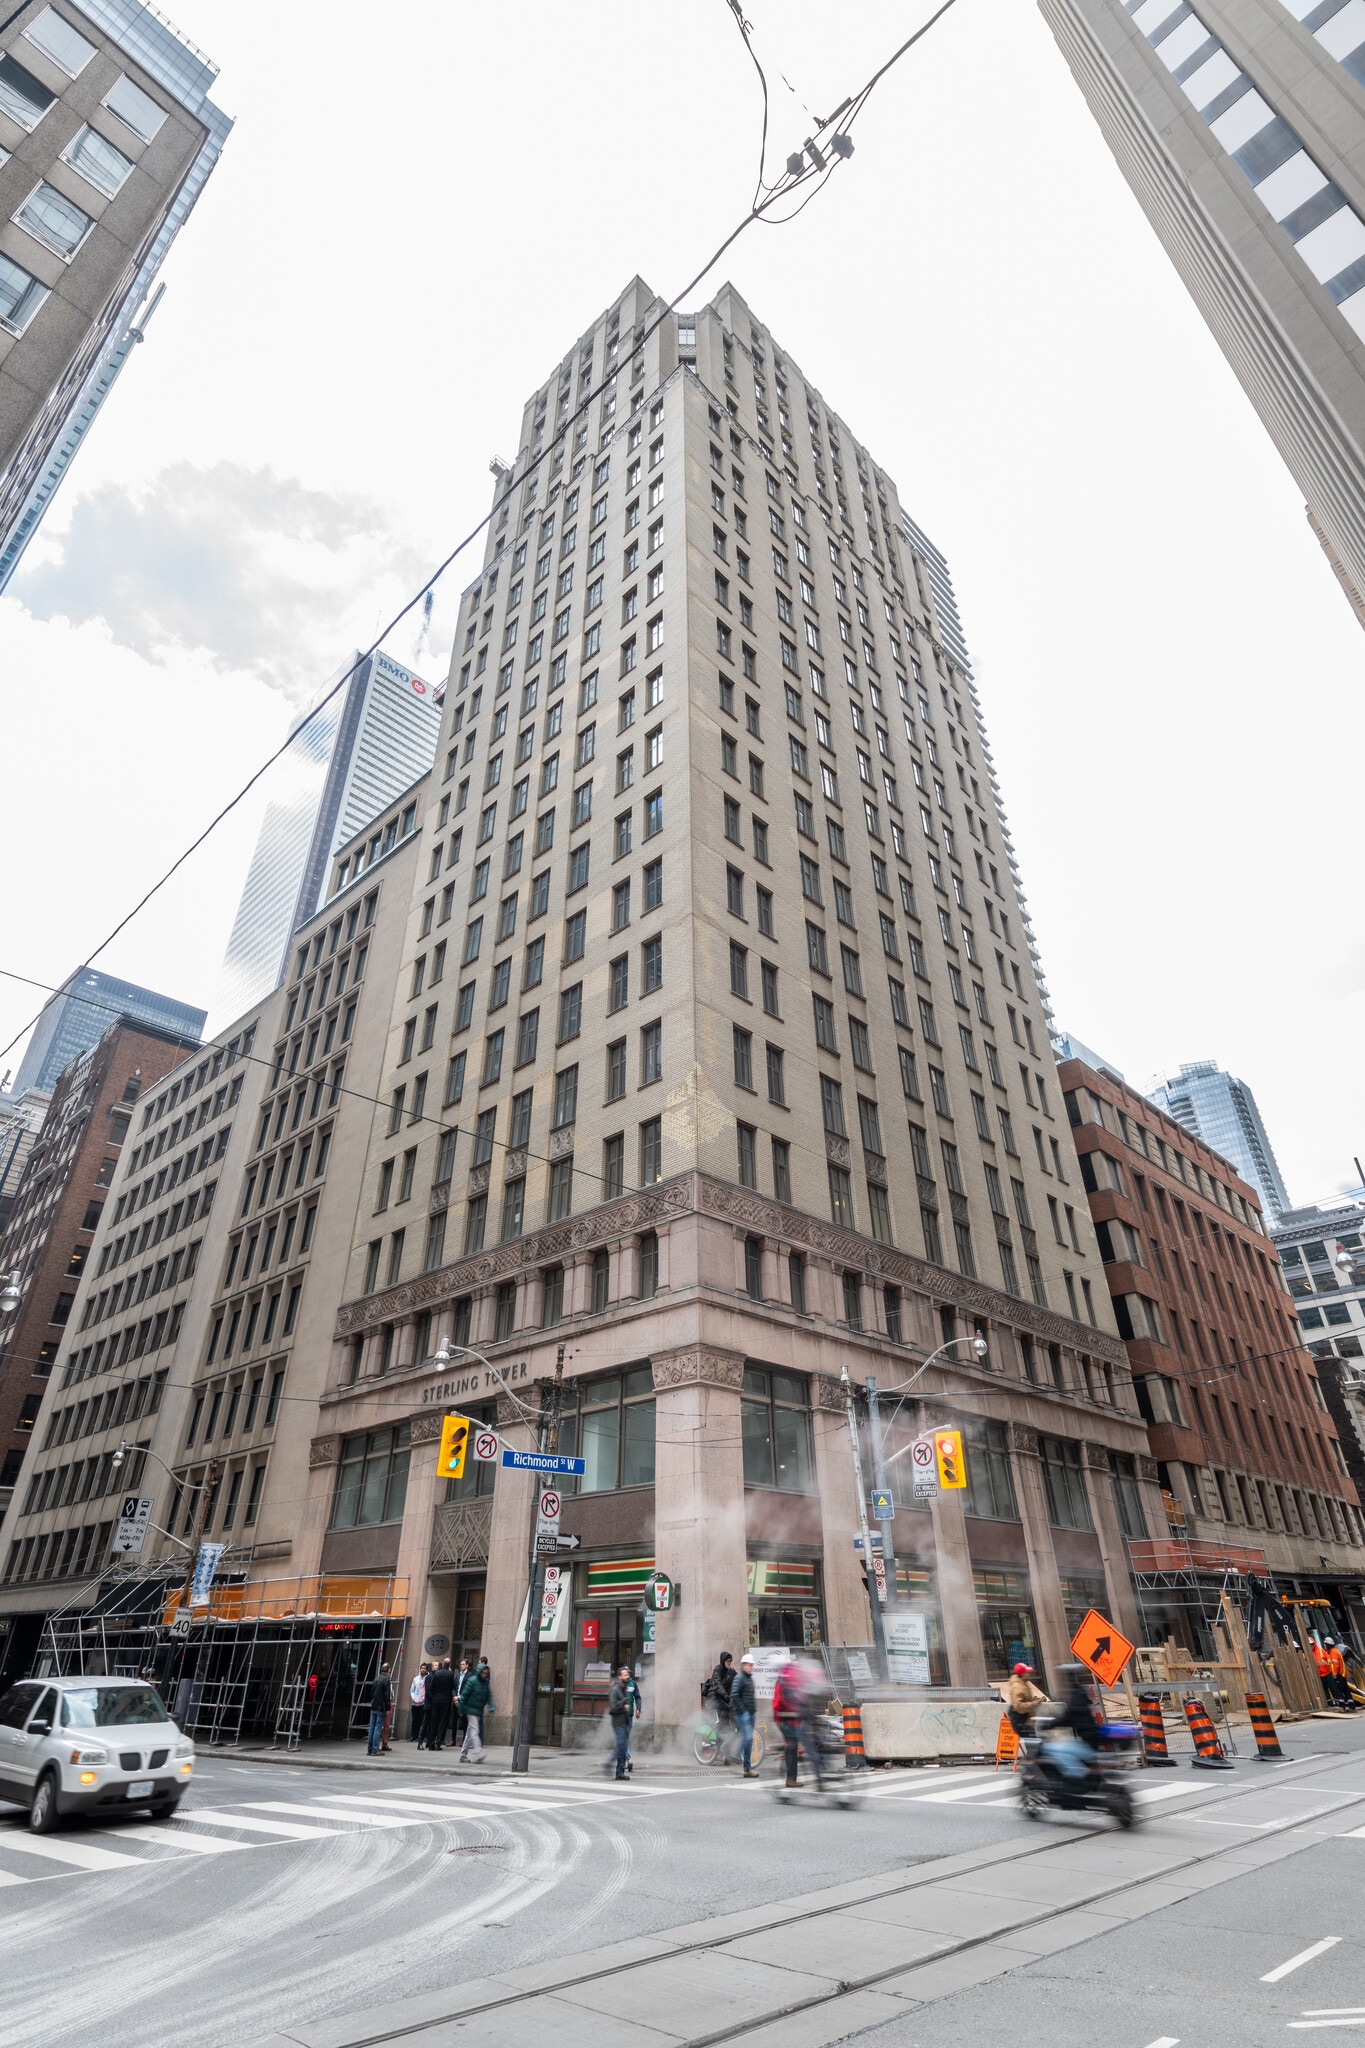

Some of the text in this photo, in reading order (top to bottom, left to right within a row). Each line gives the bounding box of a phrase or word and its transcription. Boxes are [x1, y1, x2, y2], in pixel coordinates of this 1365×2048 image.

[378, 657, 410, 683] BMO
[423, 1362, 527, 1403] STERLING TOWER
[513, 1453, 559, 1469] Richmond
[567, 1459, 575, 1471] W
[537, 1543, 556, 1551] EXCEPTED
[172, 1619, 190, 1634] 40
[429, 1639, 445, 1650] 372
